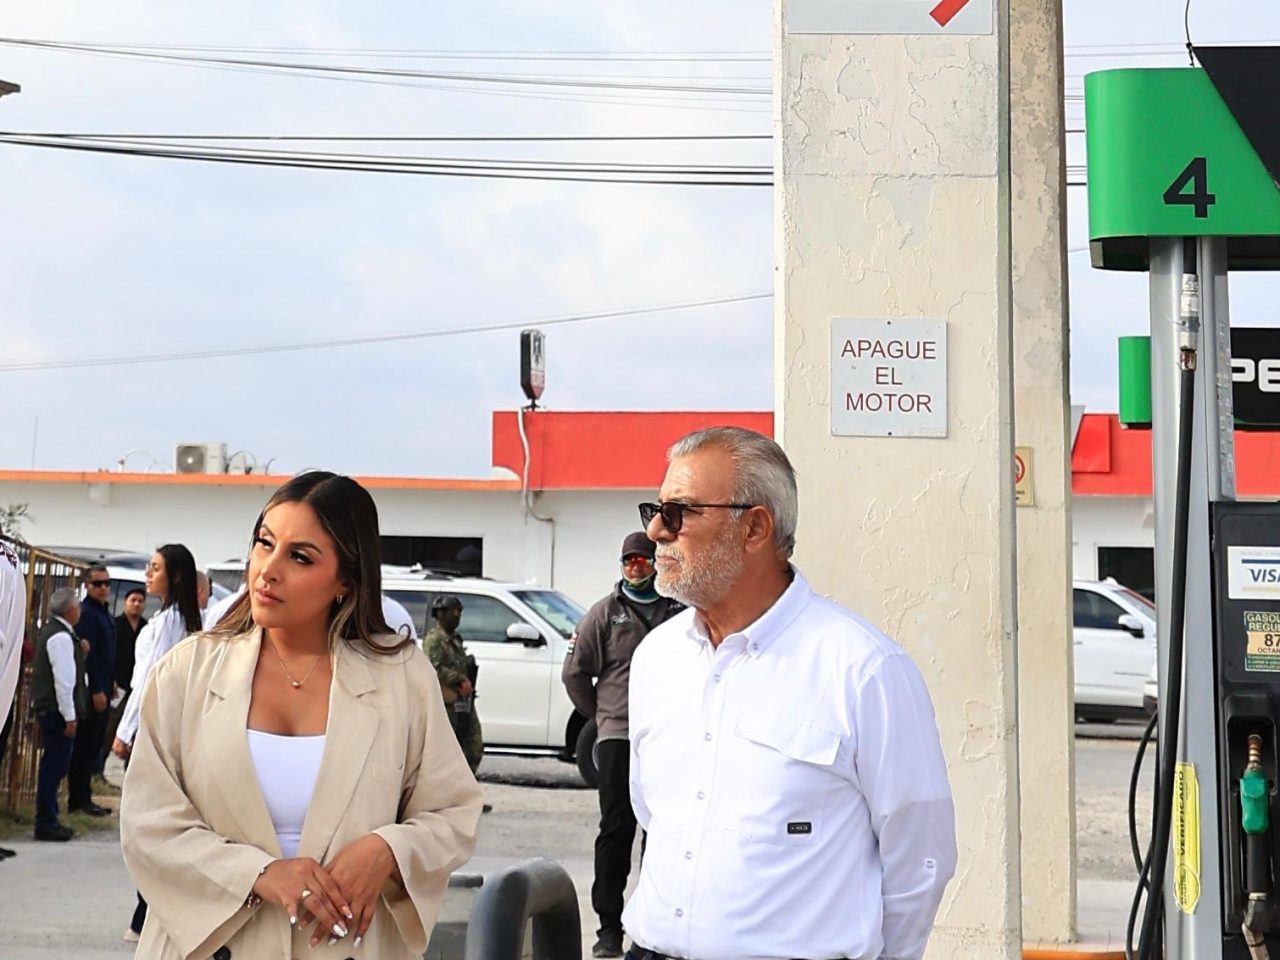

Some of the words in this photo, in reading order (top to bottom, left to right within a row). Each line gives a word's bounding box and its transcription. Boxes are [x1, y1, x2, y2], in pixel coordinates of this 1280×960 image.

[1162, 157, 1216, 219] 4
[840, 339, 936, 360] APAGUE
[875, 366, 903, 385] EL
[845, 392, 932, 413] MOTOR
[1248, 568, 1280, 583] VIS
[1248, 622, 1280, 631] REGU
[1264, 633, 1280, 647] 87
[1178, 770, 1186, 856] VERIFICADO
